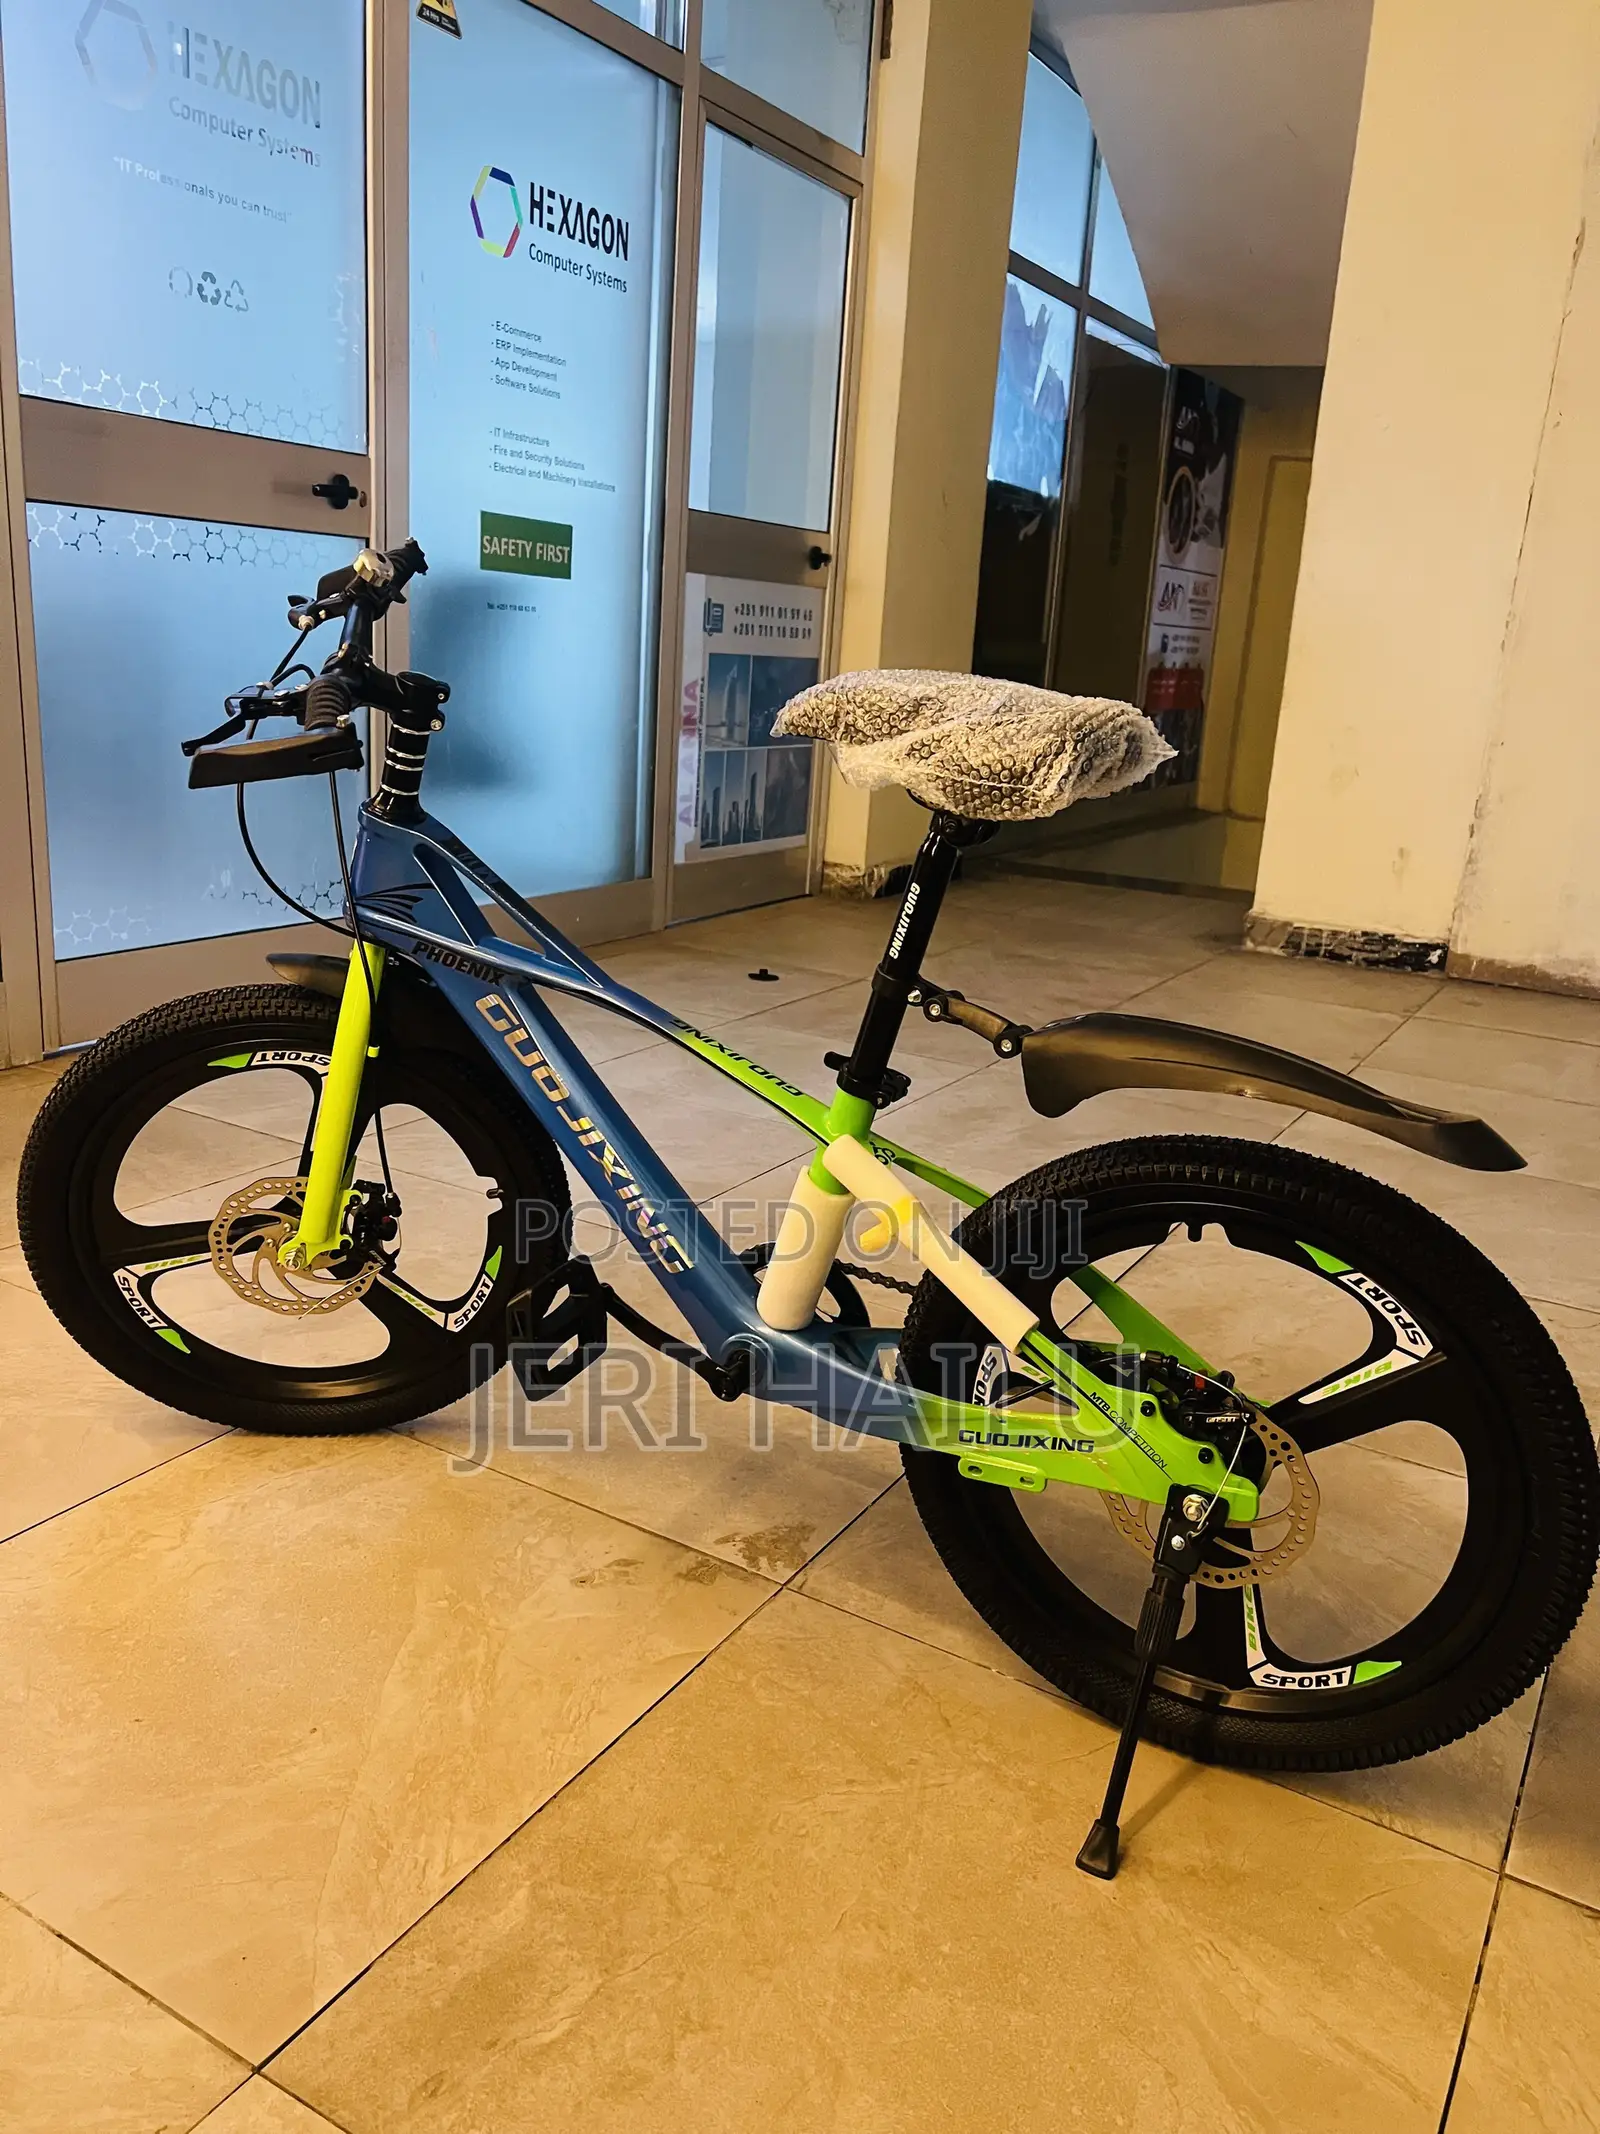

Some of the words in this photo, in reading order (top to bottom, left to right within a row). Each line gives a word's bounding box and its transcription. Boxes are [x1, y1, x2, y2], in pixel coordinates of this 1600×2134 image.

[167, 20, 320, 128] HEXAGON
[168, 96, 253, 142] Computer
[258, 128, 320, 167] Systems
[218, 191, 238, 205] you
[241, 200, 260, 213] can
[529, 181, 629, 261] HEXAGON
[529, 243, 583, 277] Computer
[586, 263, 628, 293] Systems
[495, 357, 510, 371] App
[512, 360, 557, 381] Development
[496, 338, 511, 351] ERP
[513, 343, 566, 367] Implementation
[495, 374, 526, 391] Software
[528, 383, 560, 399] Solutions
[494, 427, 500, 437] IT
[503, 429, 550, 447] Infrastructure
[494, 445, 507, 456] Fire
[510, 449, 523, 458] and
[524, 450, 552, 466] Security
[554, 456, 585, 471] Solutions
[494, 462, 527, 476] Electrical
[528, 469, 541, 479] and
[543, 470, 576, 487] Machinery
[483, 535, 532, 558] SAFETY
[536, 542, 570, 564] FIRST
[734, 603, 755, 616] +251
[760, 605, 774, 618] 911
[777, 606, 787, 619] 01
[734, 622, 754, 636] +251
[759, 625, 773, 637] 711
[889, 882, 921, 959] GUOJIXING
[411, 940, 505, 987] PHOENIX
[256, 1052, 331, 1066] SPORT
[669, 1019, 804, 1096] GUOJIXING
[476, 993, 695, 1275] GUOJIXING
[118, 1275, 162, 1325] SPORT
[454, 1279, 491, 1328] SPORT
[1347, 1277, 1426, 1346] SPORT
[974, 1351, 997, 1406] SPOR
[1322, 1360, 1392, 1396] BIKE
[958, 1429, 1095, 1454] GUOJIXING
[1090, 1391, 1111, 1412] MTB
[1109, 1410, 1168, 1470] COMPETITION
[1245, 1584, 1257, 1651] BIKE
[1260, 1670, 1347, 1688] SPORT
